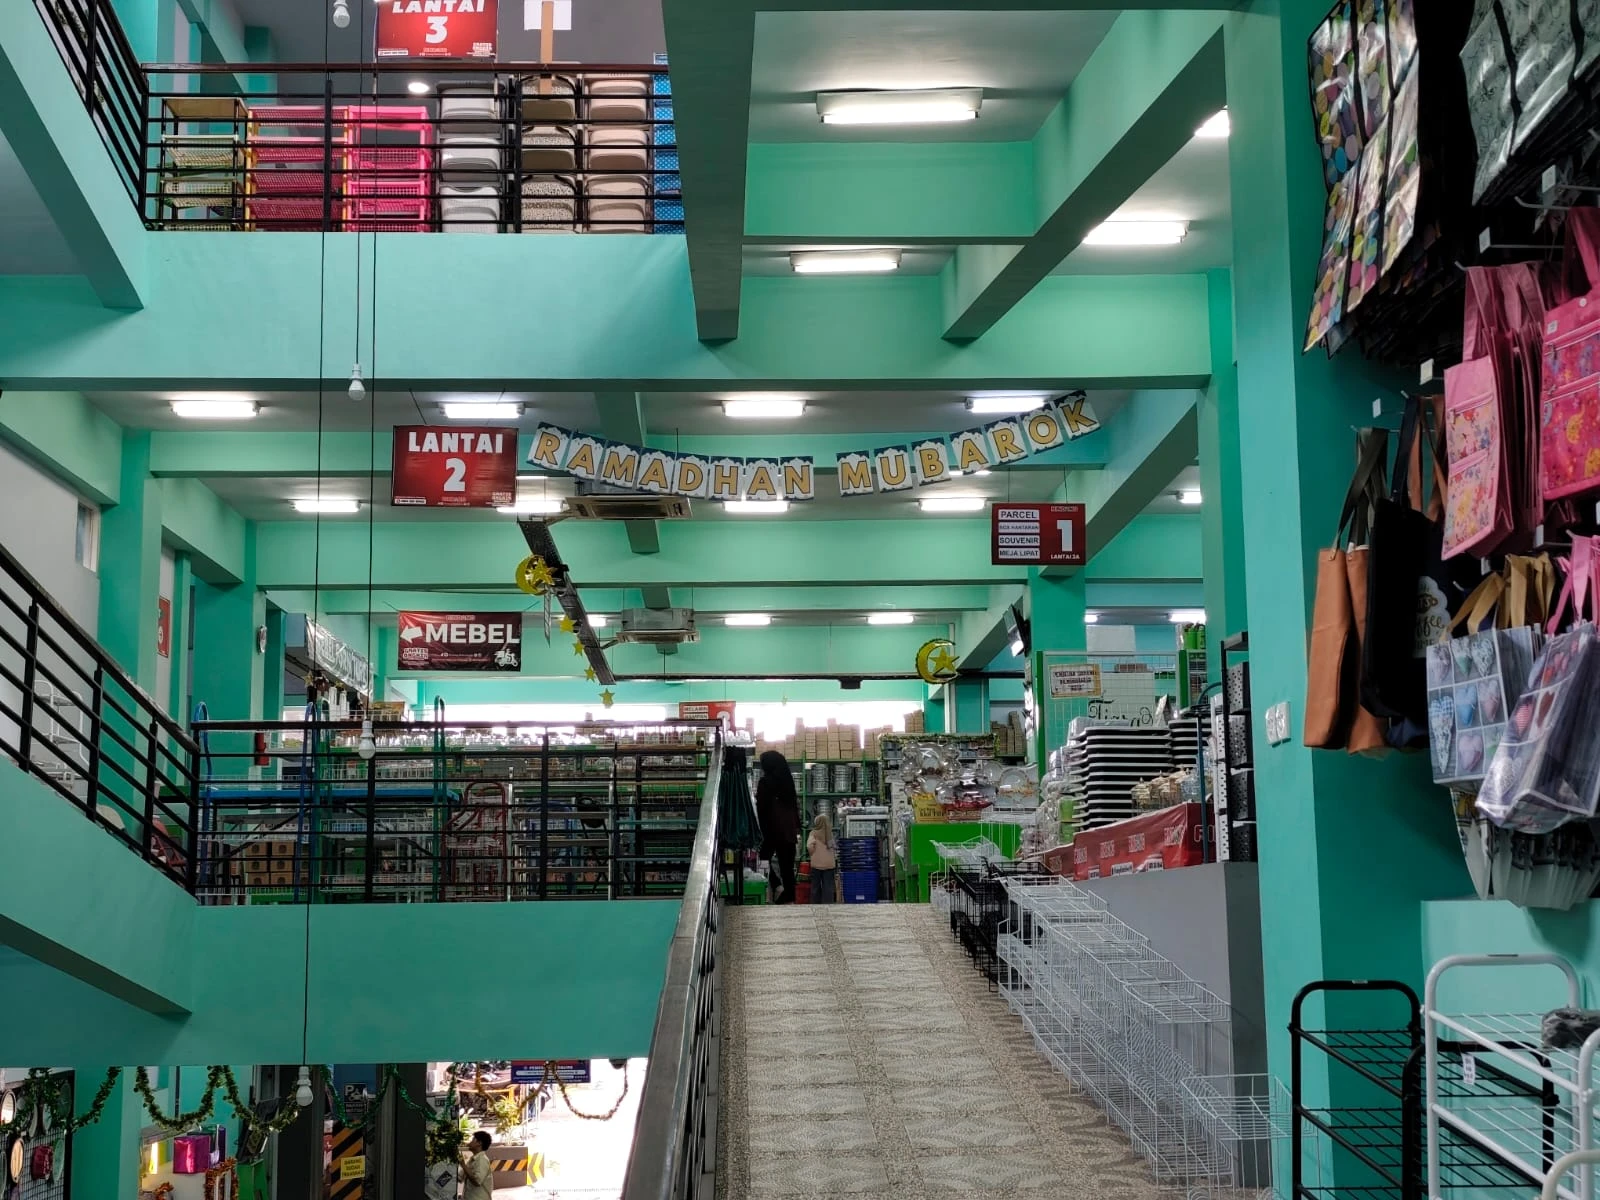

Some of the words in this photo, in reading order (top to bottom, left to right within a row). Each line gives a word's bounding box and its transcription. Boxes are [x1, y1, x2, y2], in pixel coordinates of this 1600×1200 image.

[392, 0, 485, 13] LANTAI
[425, 16, 448, 43] 3
[408, 431, 503, 453] LANTAI
[534, 431, 811, 496] RAMADHAN
[841, 397, 1097, 490] MUBAROK
[443, 457, 466, 492] 2
[1001, 511, 1037, 519] PARCEL
[1057, 520, 1073, 552] 1
[425, 623, 520, 643] MEBEL
